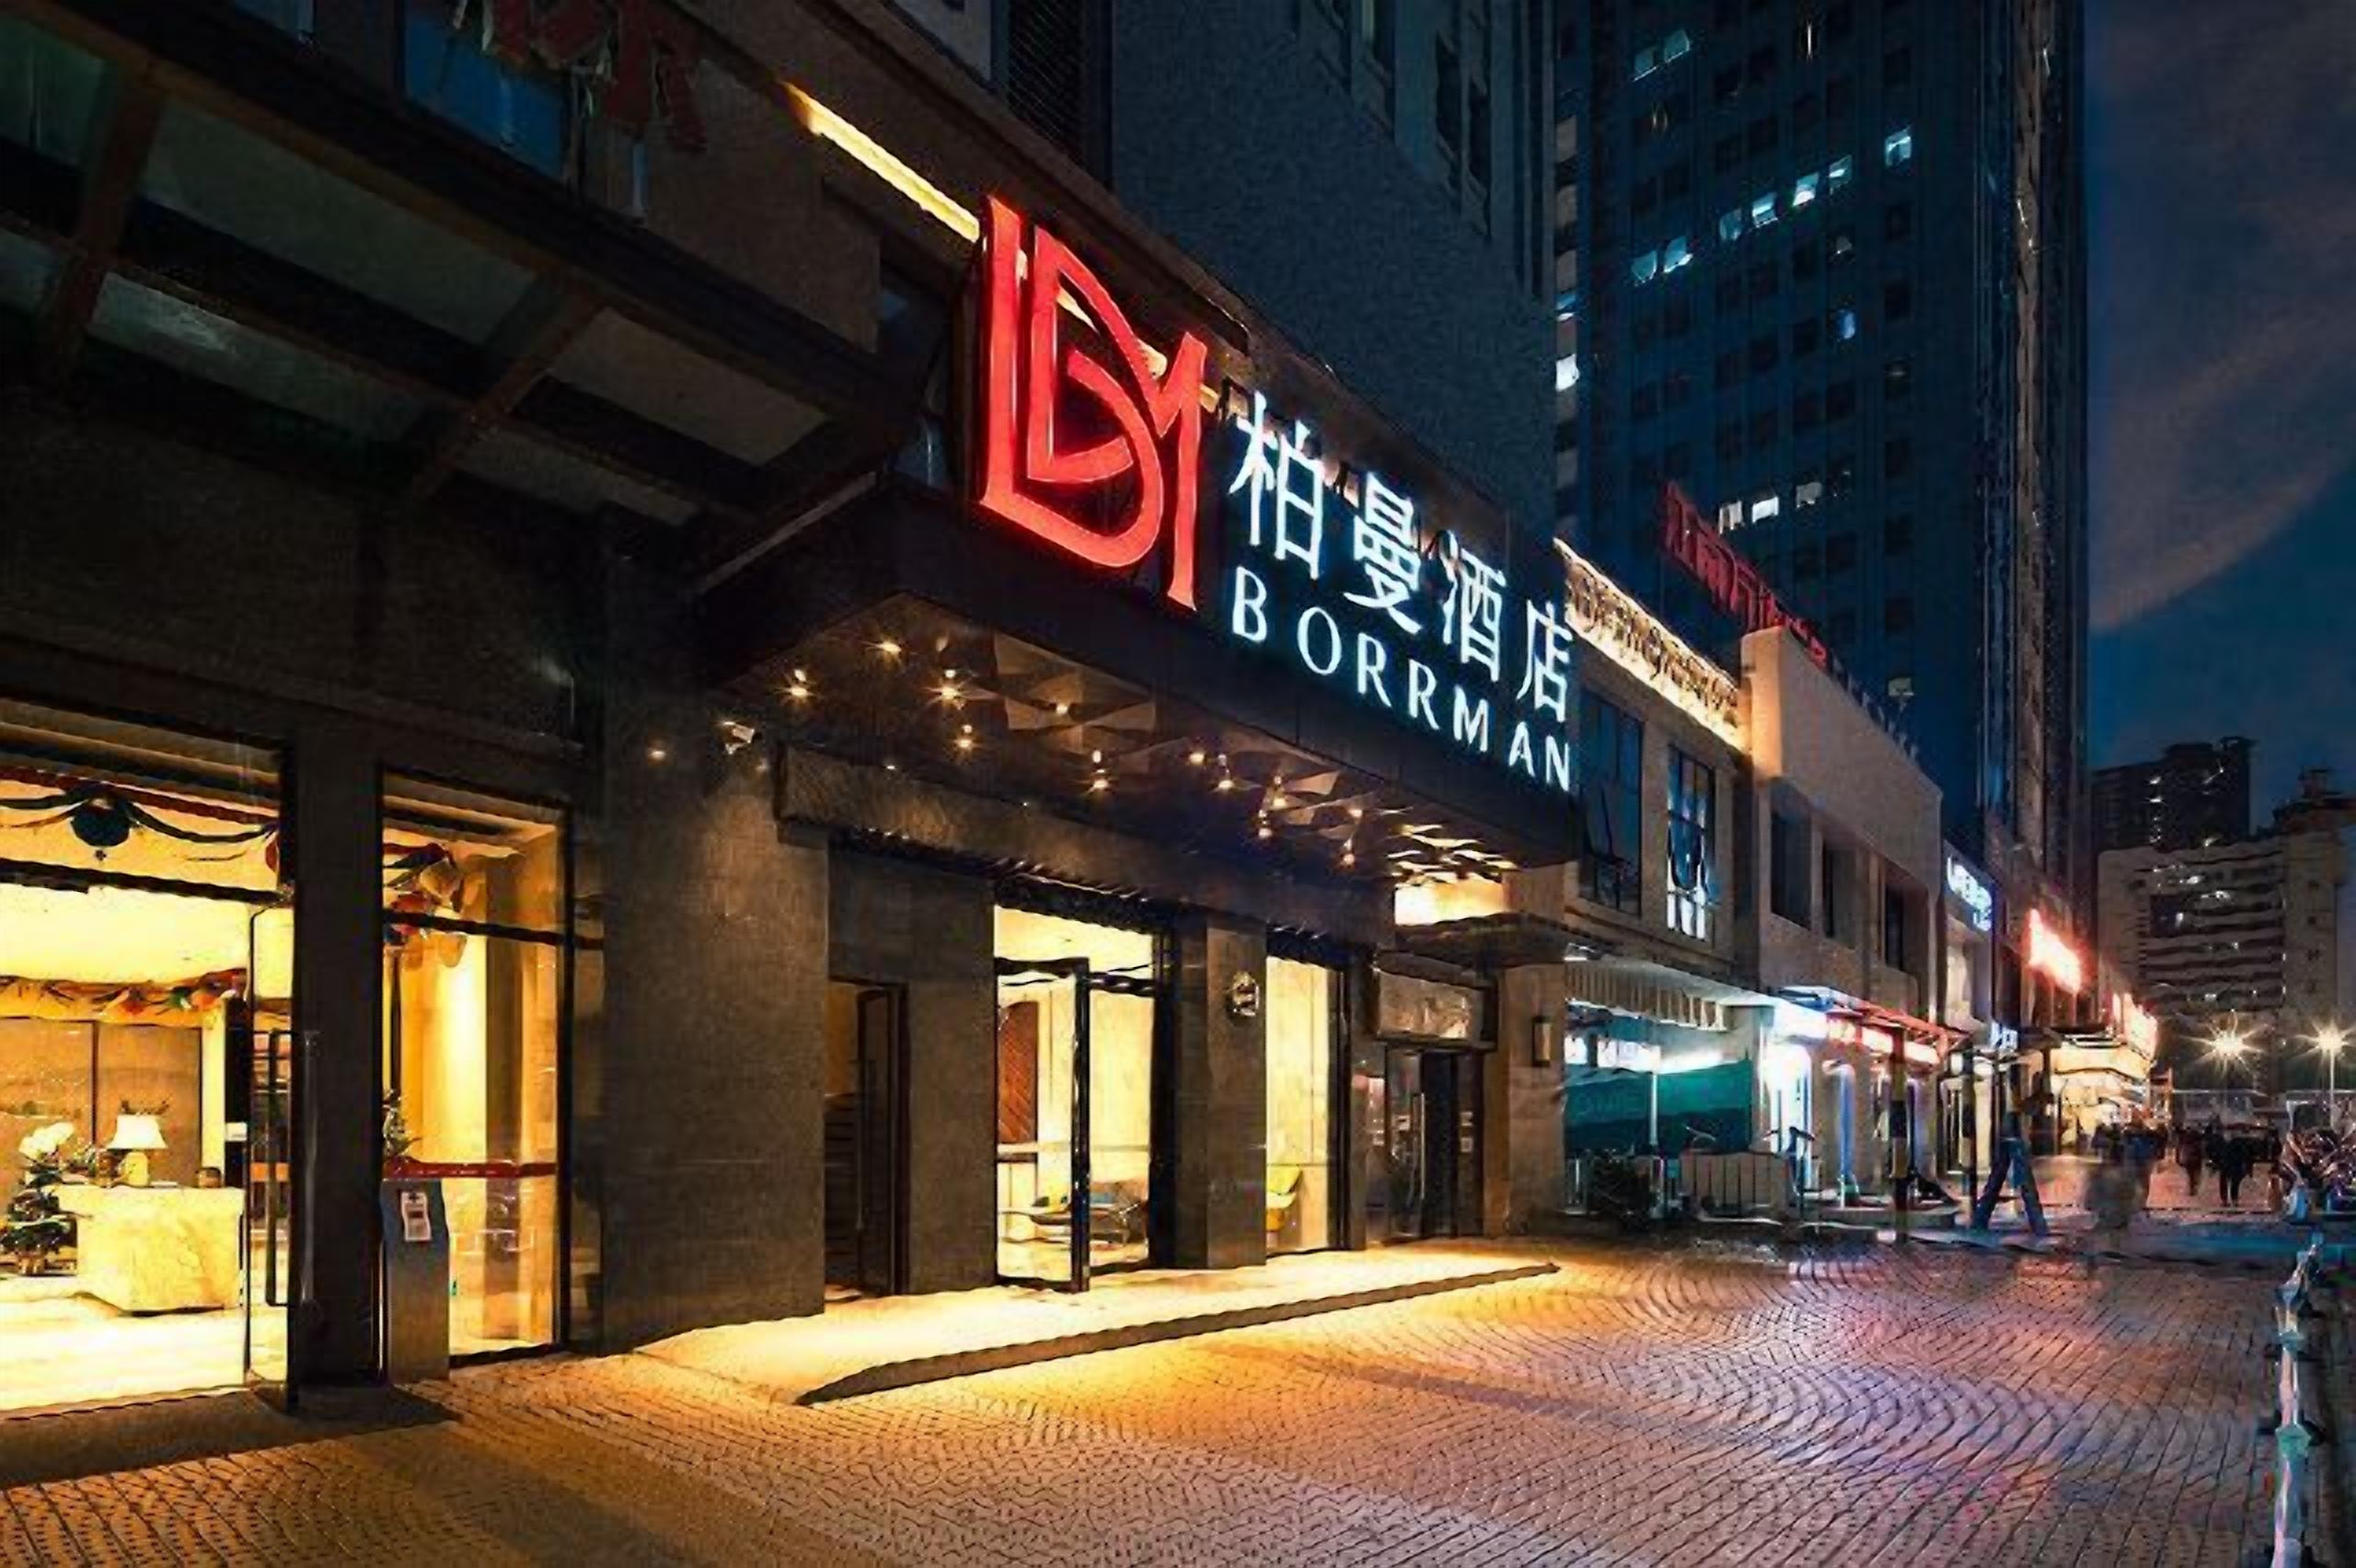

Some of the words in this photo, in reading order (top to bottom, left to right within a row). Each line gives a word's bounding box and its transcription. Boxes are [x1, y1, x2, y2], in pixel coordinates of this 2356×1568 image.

[1229, 390, 1573, 723] 柏曼酒店
[1231, 565, 1570, 792] BORRMAN
